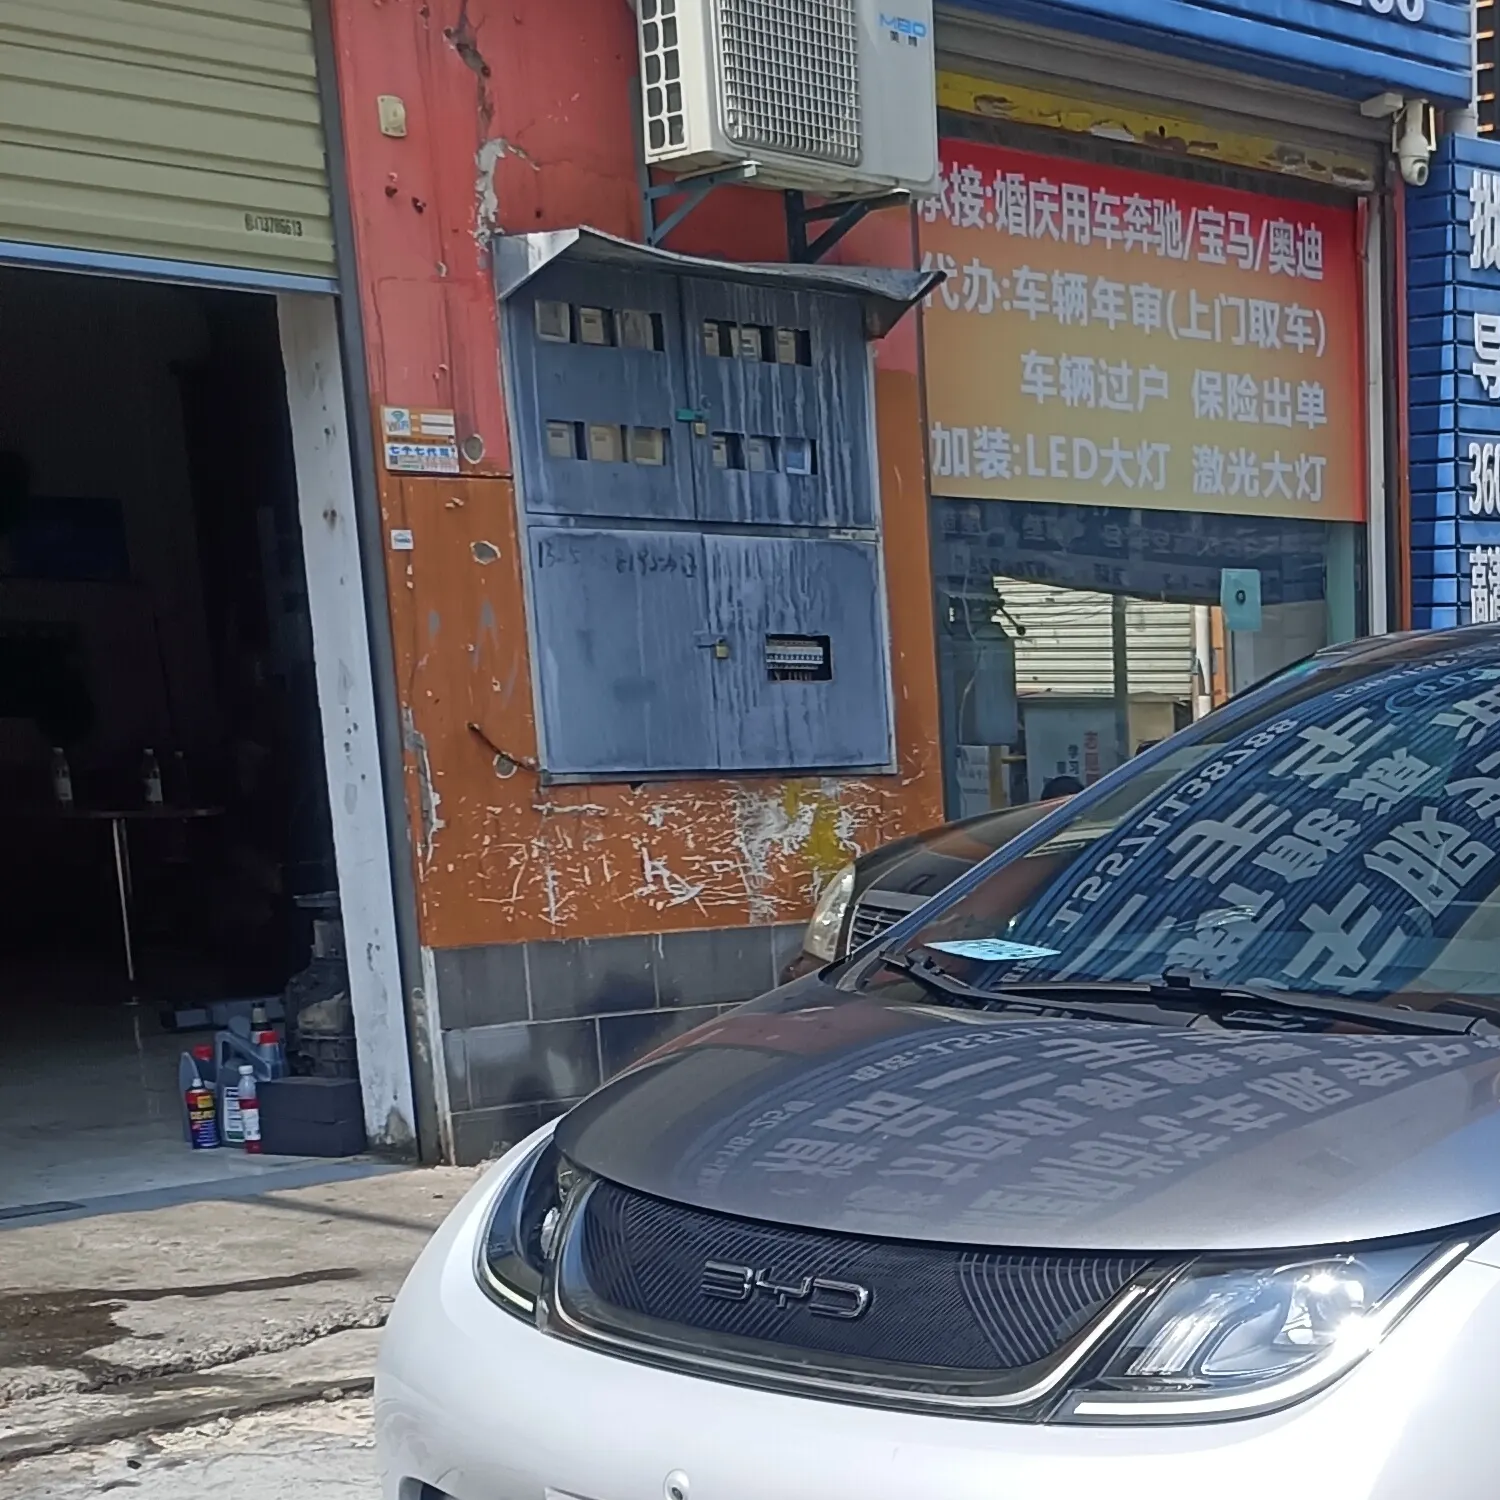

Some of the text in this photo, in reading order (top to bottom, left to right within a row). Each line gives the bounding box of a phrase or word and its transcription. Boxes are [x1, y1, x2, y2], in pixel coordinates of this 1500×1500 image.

[920, 251, 1326, 356] 代办:车辆年审(上门取车)
[1020, 350, 1327, 430] 车辆过户 保险出单
[931, 425, 1327, 502] 加装:LED大灯 激光大灯
[701, 1260, 870, 1319] BYD
